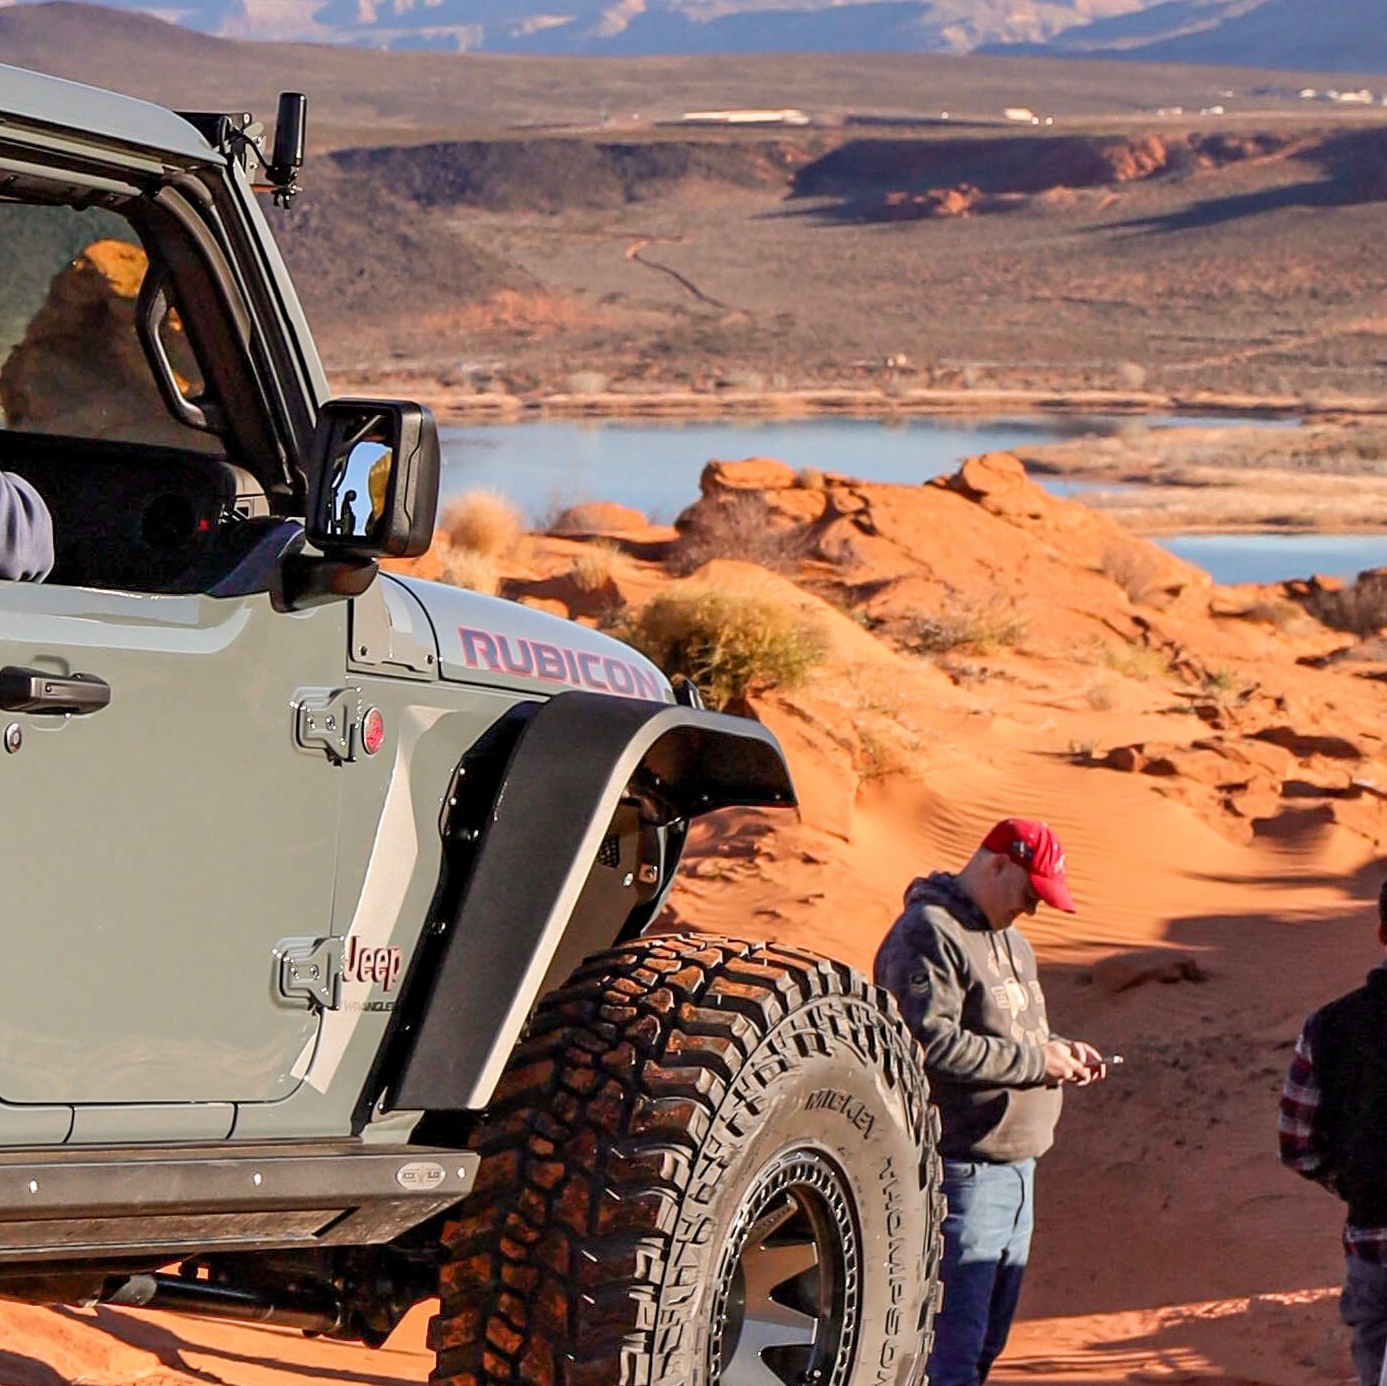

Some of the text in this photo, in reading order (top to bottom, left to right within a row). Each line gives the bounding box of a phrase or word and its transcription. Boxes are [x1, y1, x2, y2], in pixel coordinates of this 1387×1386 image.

[457, 625, 666, 701] RUBICON
[342, 935, 402, 993] Jeep
[804, 1089, 877, 1140] MICKEY
